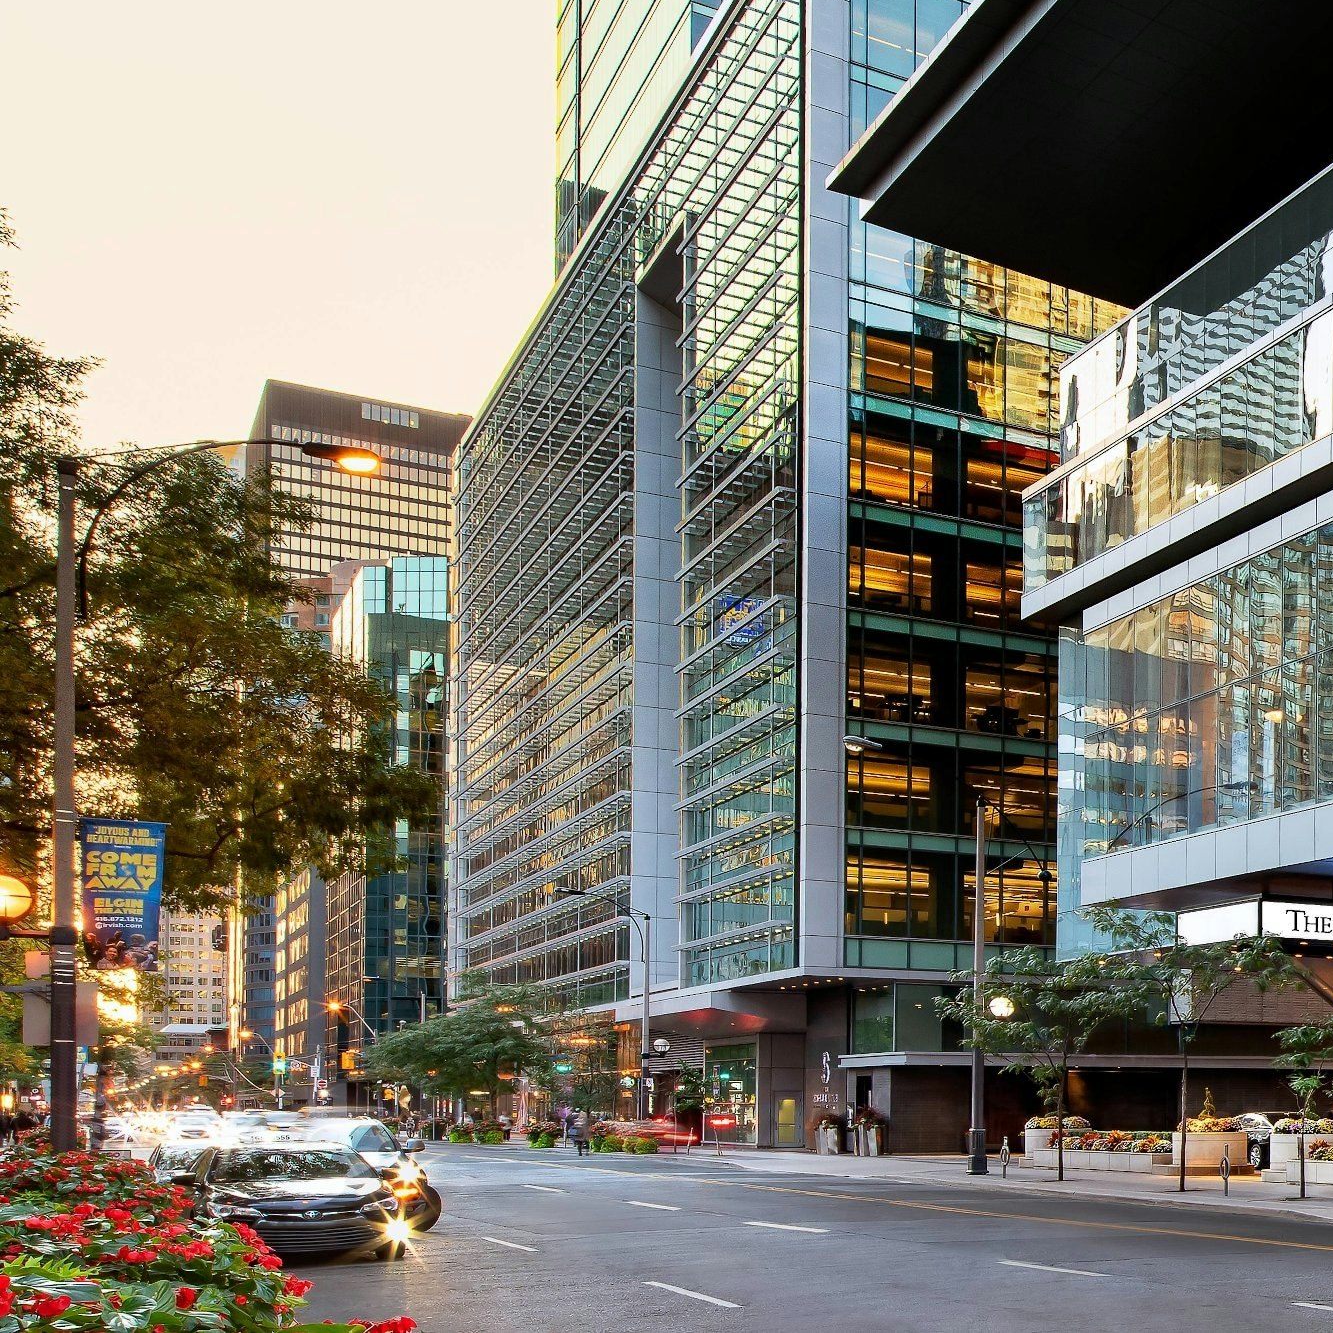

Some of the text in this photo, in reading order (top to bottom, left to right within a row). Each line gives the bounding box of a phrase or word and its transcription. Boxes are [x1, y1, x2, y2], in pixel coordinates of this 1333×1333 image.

[86, 851, 157, 866] COME
[85, 876, 156, 890] AWAY
[94, 898, 143, 908] ELGIN
[1285, 909, 1332, 934] THE
